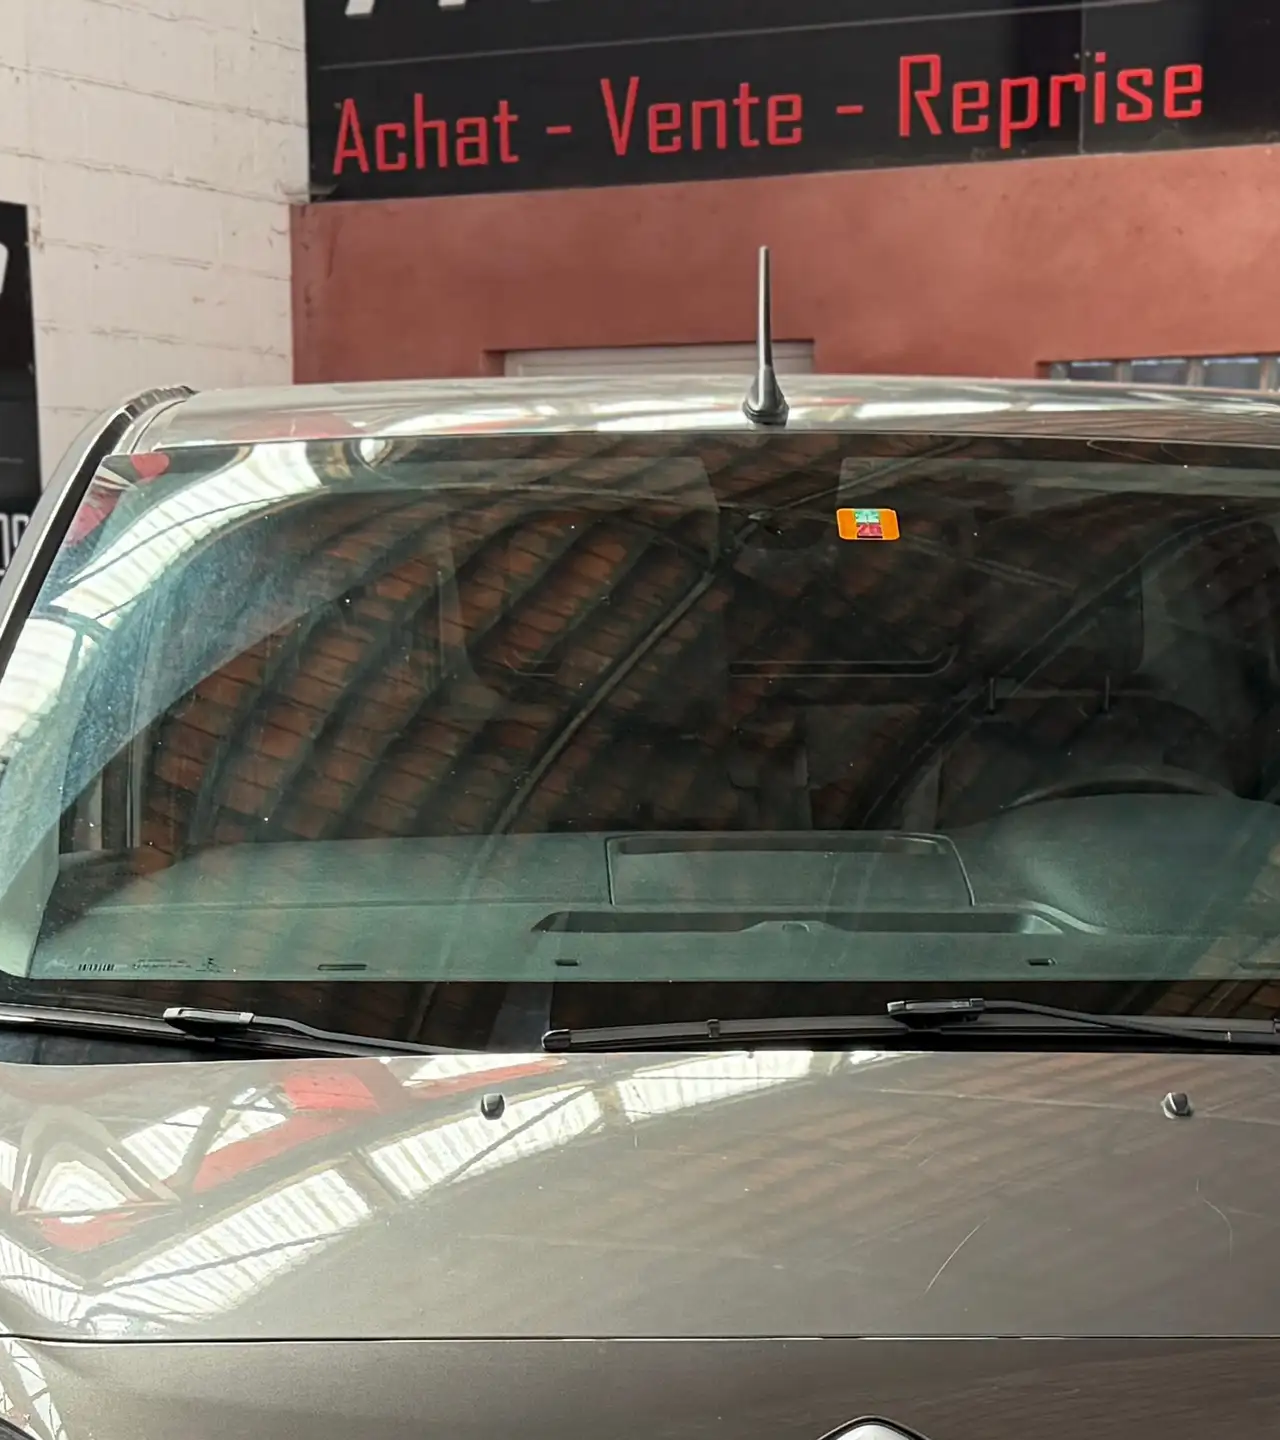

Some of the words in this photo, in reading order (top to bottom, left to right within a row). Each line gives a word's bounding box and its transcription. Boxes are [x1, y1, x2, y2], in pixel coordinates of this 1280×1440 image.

[333, 94, 519, 175] Achat
[600, 76, 803, 157] Vente
[898, 52, 1204, 150] Reprise
